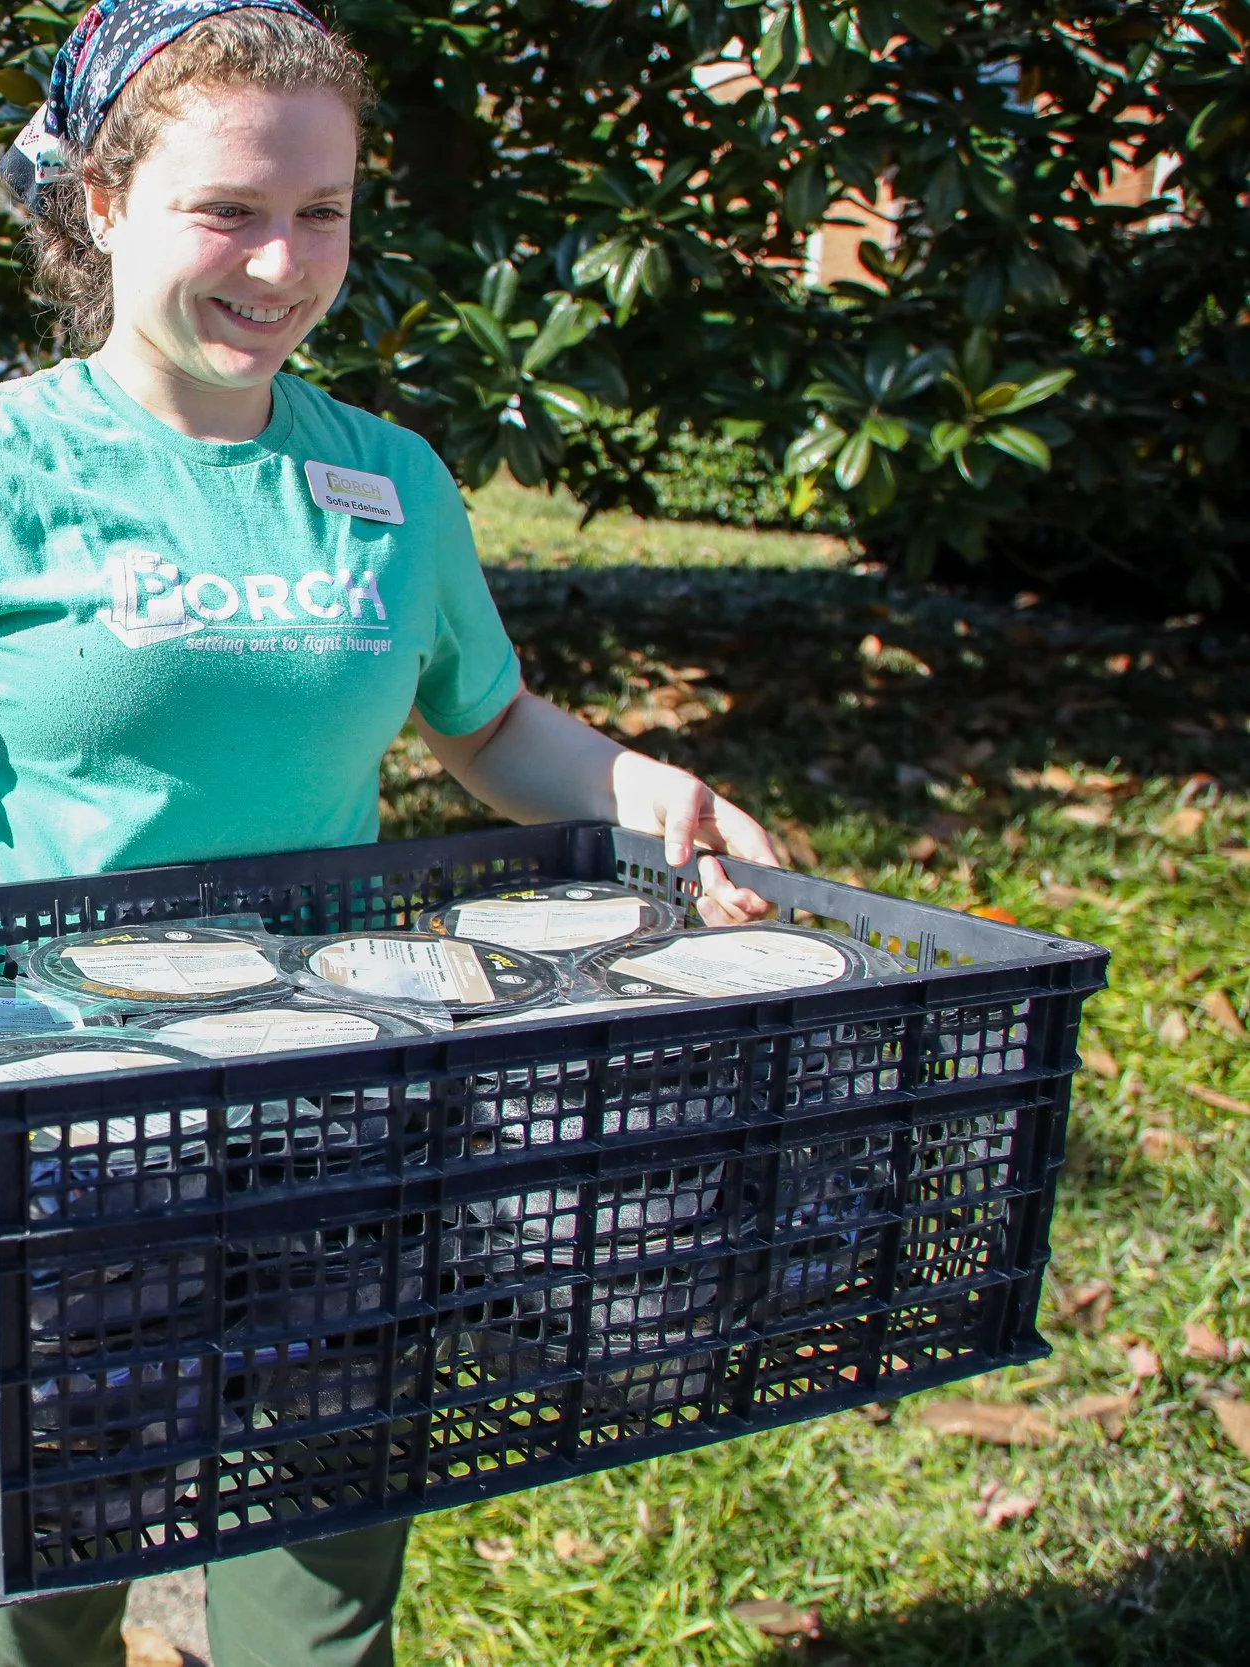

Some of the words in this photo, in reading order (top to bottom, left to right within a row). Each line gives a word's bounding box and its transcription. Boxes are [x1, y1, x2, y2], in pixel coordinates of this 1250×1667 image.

[327, 471, 382, 497] PORCH
[325, 496, 350, 508] Sofia
[351, 501, 391, 516] Edelman
[132, 567, 387, 622] PORCH
[185, 634, 245, 656] setting
[249, 637, 278, 652] out
[281, 637, 298, 651] to
[302, 634, 342, 655] fight
[346, 635, 393, 656] hunger
